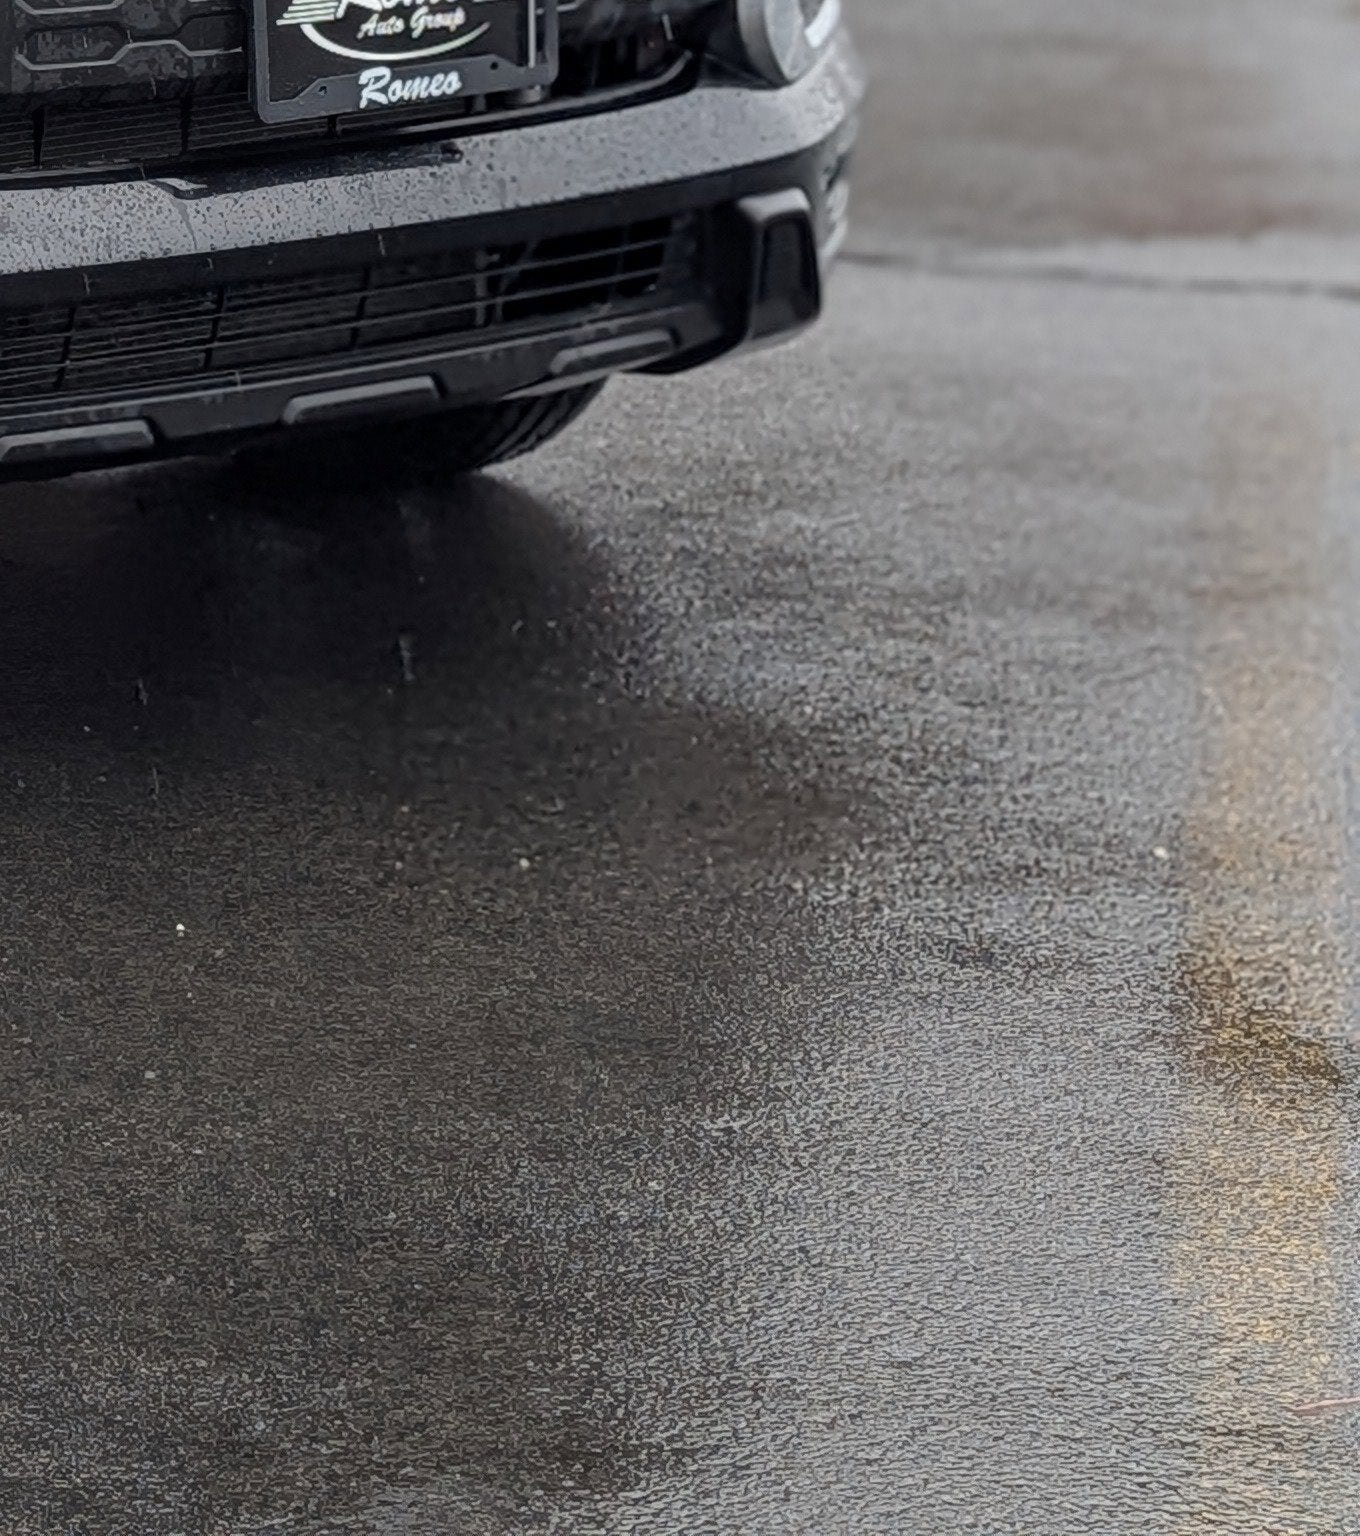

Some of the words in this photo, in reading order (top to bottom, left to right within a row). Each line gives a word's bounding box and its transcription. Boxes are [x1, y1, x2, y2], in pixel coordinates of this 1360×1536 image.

[356, 12, 406, 40] Auto
[409, 5, 467, 40] Group
[358, 65, 462, 109] Romeo
